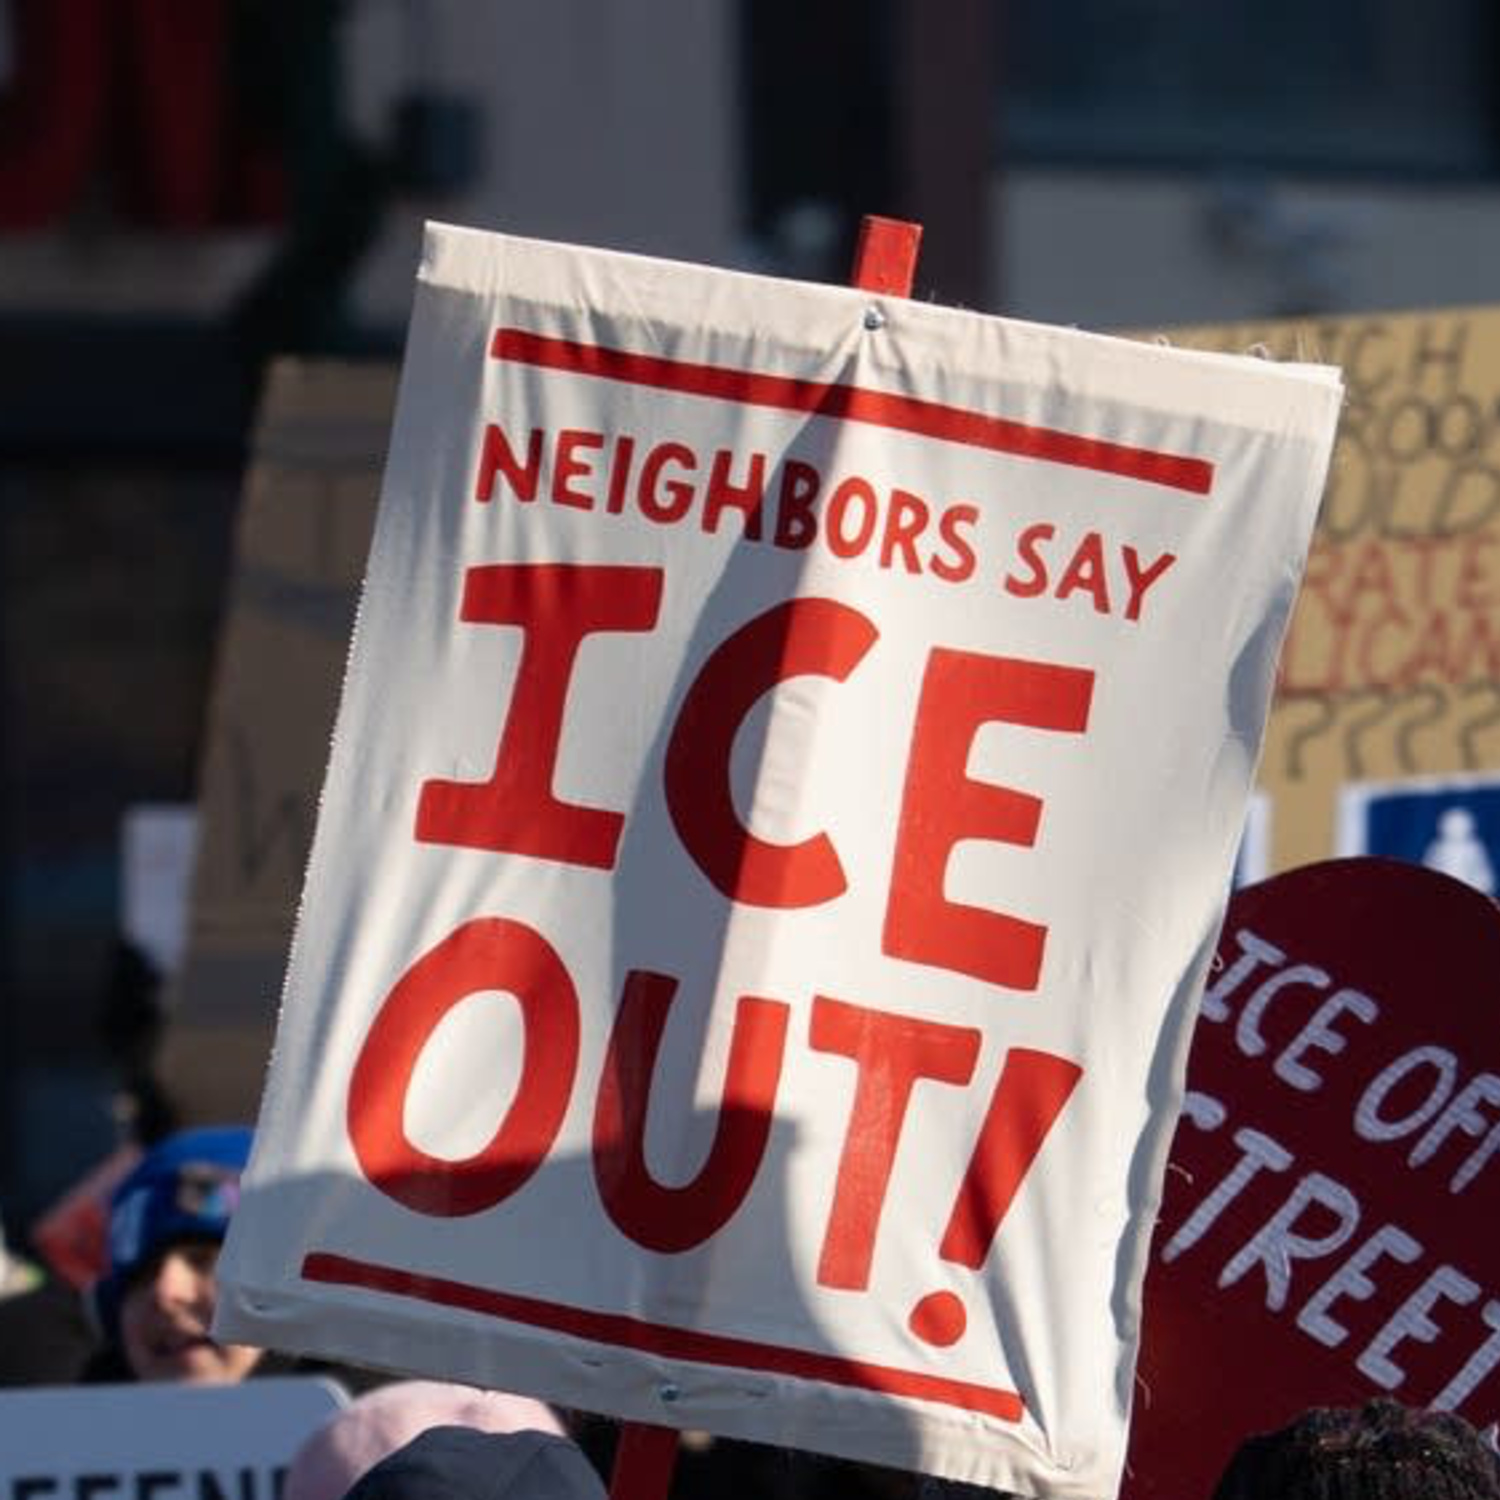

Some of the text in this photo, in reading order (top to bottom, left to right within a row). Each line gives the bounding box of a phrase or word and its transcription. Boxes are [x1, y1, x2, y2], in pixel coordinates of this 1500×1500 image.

[475, 426, 1177, 622] NEIGHBORS SAY
[412, 562, 1095, 994] ICE
[348, 915, 1085, 1349] OUT!
[1200, 929, 1379, 1091] ICE
